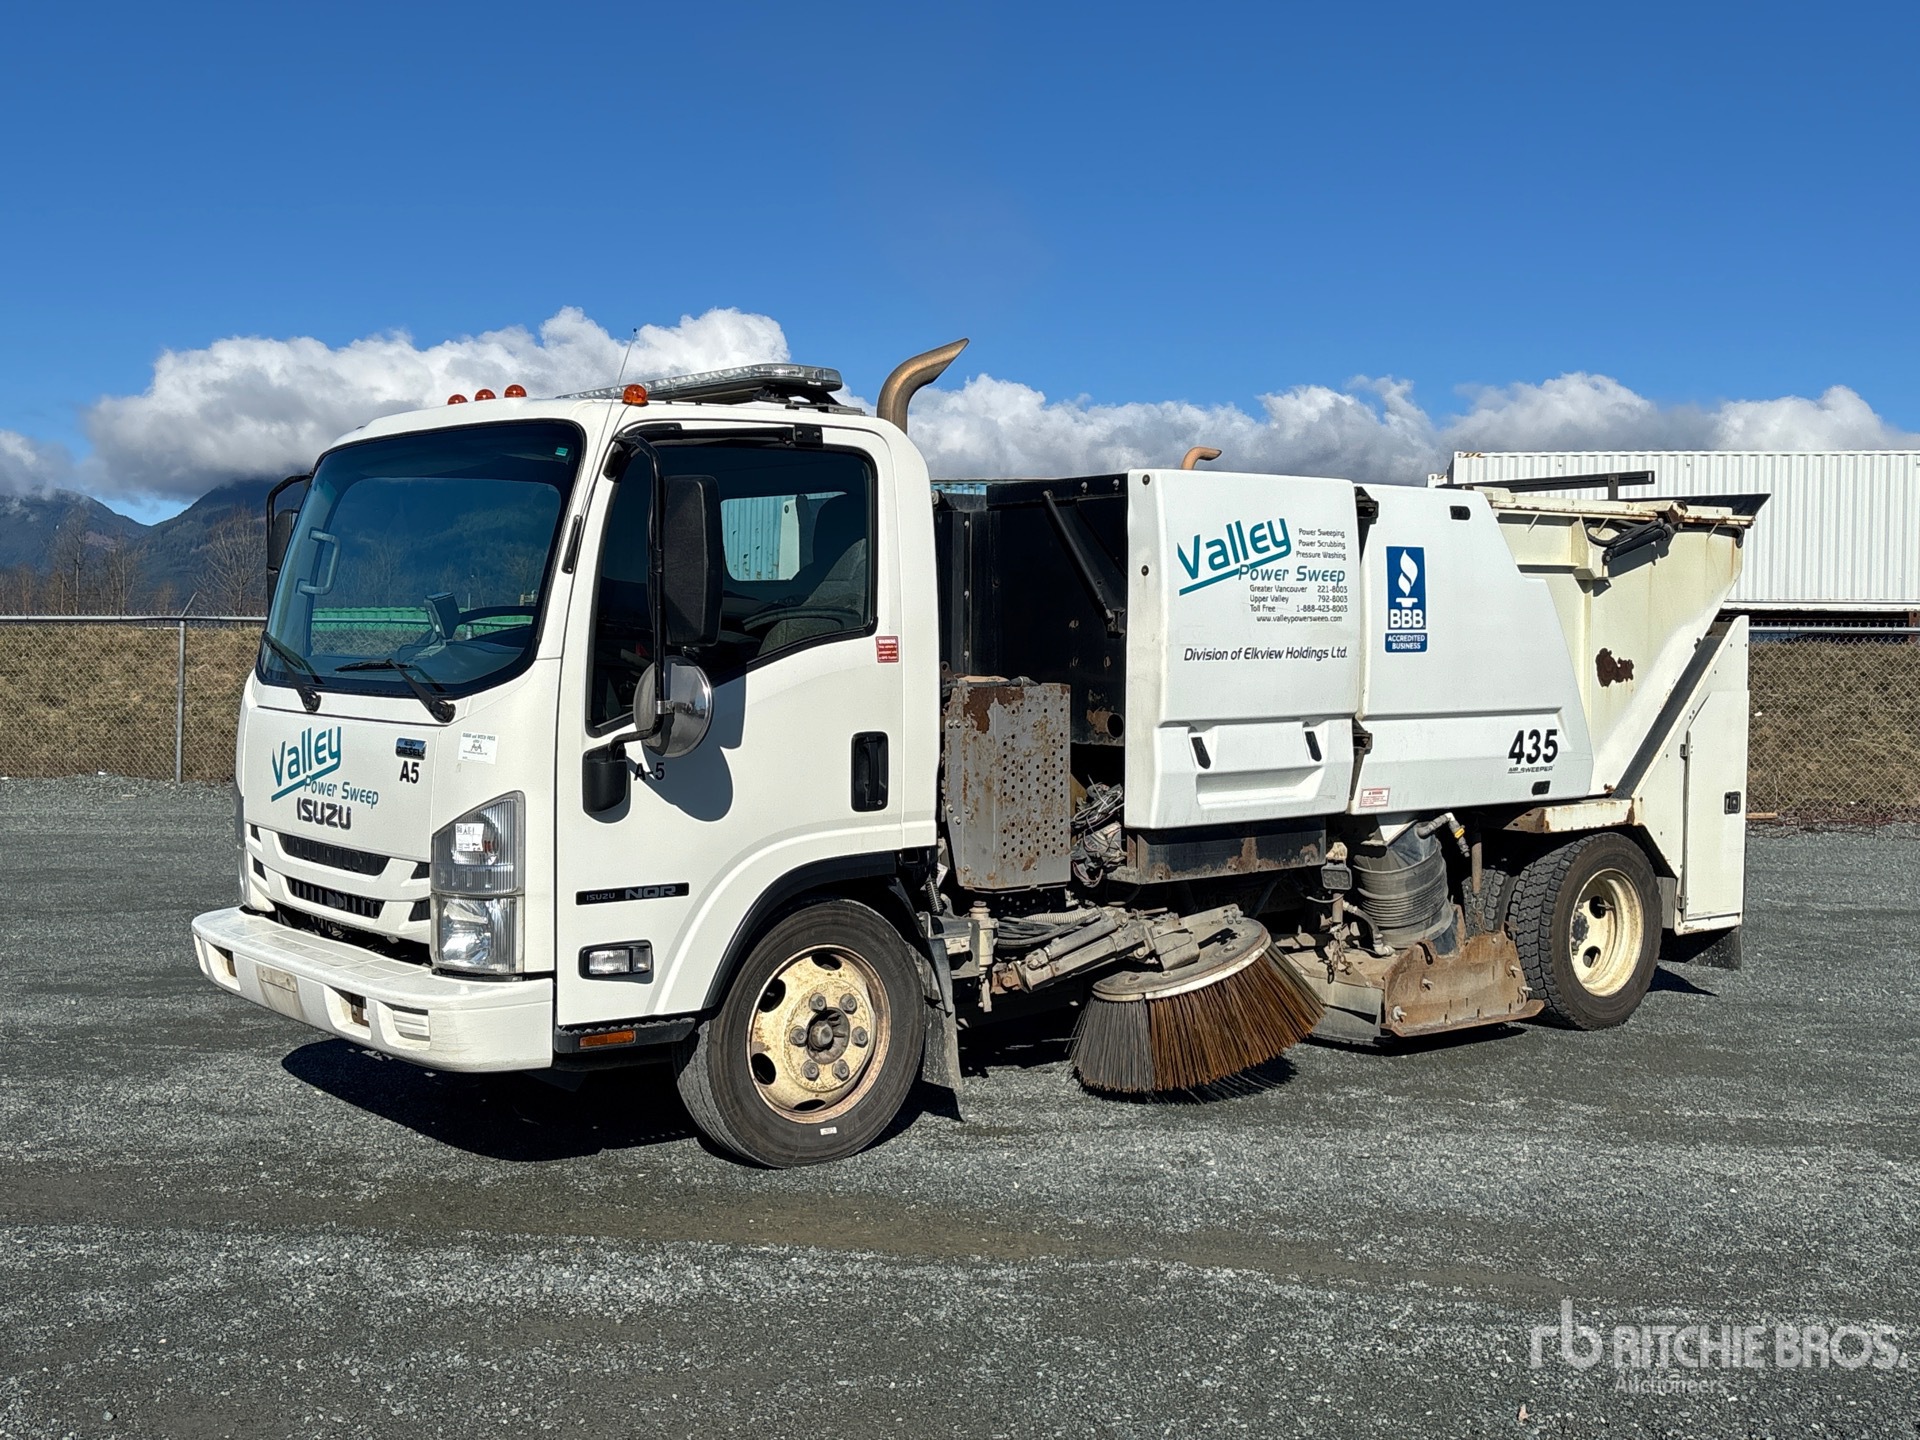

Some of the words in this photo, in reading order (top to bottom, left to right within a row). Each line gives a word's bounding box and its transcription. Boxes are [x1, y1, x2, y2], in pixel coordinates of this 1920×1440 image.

[1299, 528, 1316, 536] Power
[1317, 529, 1346, 539] Sweeping
[1177, 518, 1292, 581] Valley
[1298, 539, 1316, 547] Power
[1317, 540, 1346, 550] Scrubbing
[1295, 551, 1322, 559] Pressure
[1322, 552, 1347, 561] Washing
[1238, 564, 1290, 582] Power
[1296, 565, 1346, 587] Sweep
[1249, 584, 1274, 593] Greater
[1274, 585, 1308, 593] Vancouver
[1249, 594, 1269, 604] Upper
[1270, 595, 1290, 604] Valley
[1249, 604, 1261, 612] Toll
[1262, 604, 1276, 612] Free
[1390, 609, 1424, 628] BBB
[1388, 634, 1426, 642] ACCREDITED
[1391, 642, 1421, 650] BUSINESS
[1184, 647, 1229, 661] Division
[1230, 648, 1243, 660] of
[1244, 647, 1285, 660] Elkview
[1285, 646, 1330, 662] Holdings
[1330, 646, 1348, 659] Ltd.
[1508, 729, 1558, 765] 435
[271, 726, 342, 788] Valley
[399, 760, 420, 784] A5
[633, 762, 665, 781] A-5
[304, 775, 338, 798] Power
[341, 781, 379, 810] Sweep
[296, 797, 352, 830] ISUZU
[586, 892, 616, 901] ISUZU
[625, 885, 677, 900] NQR
